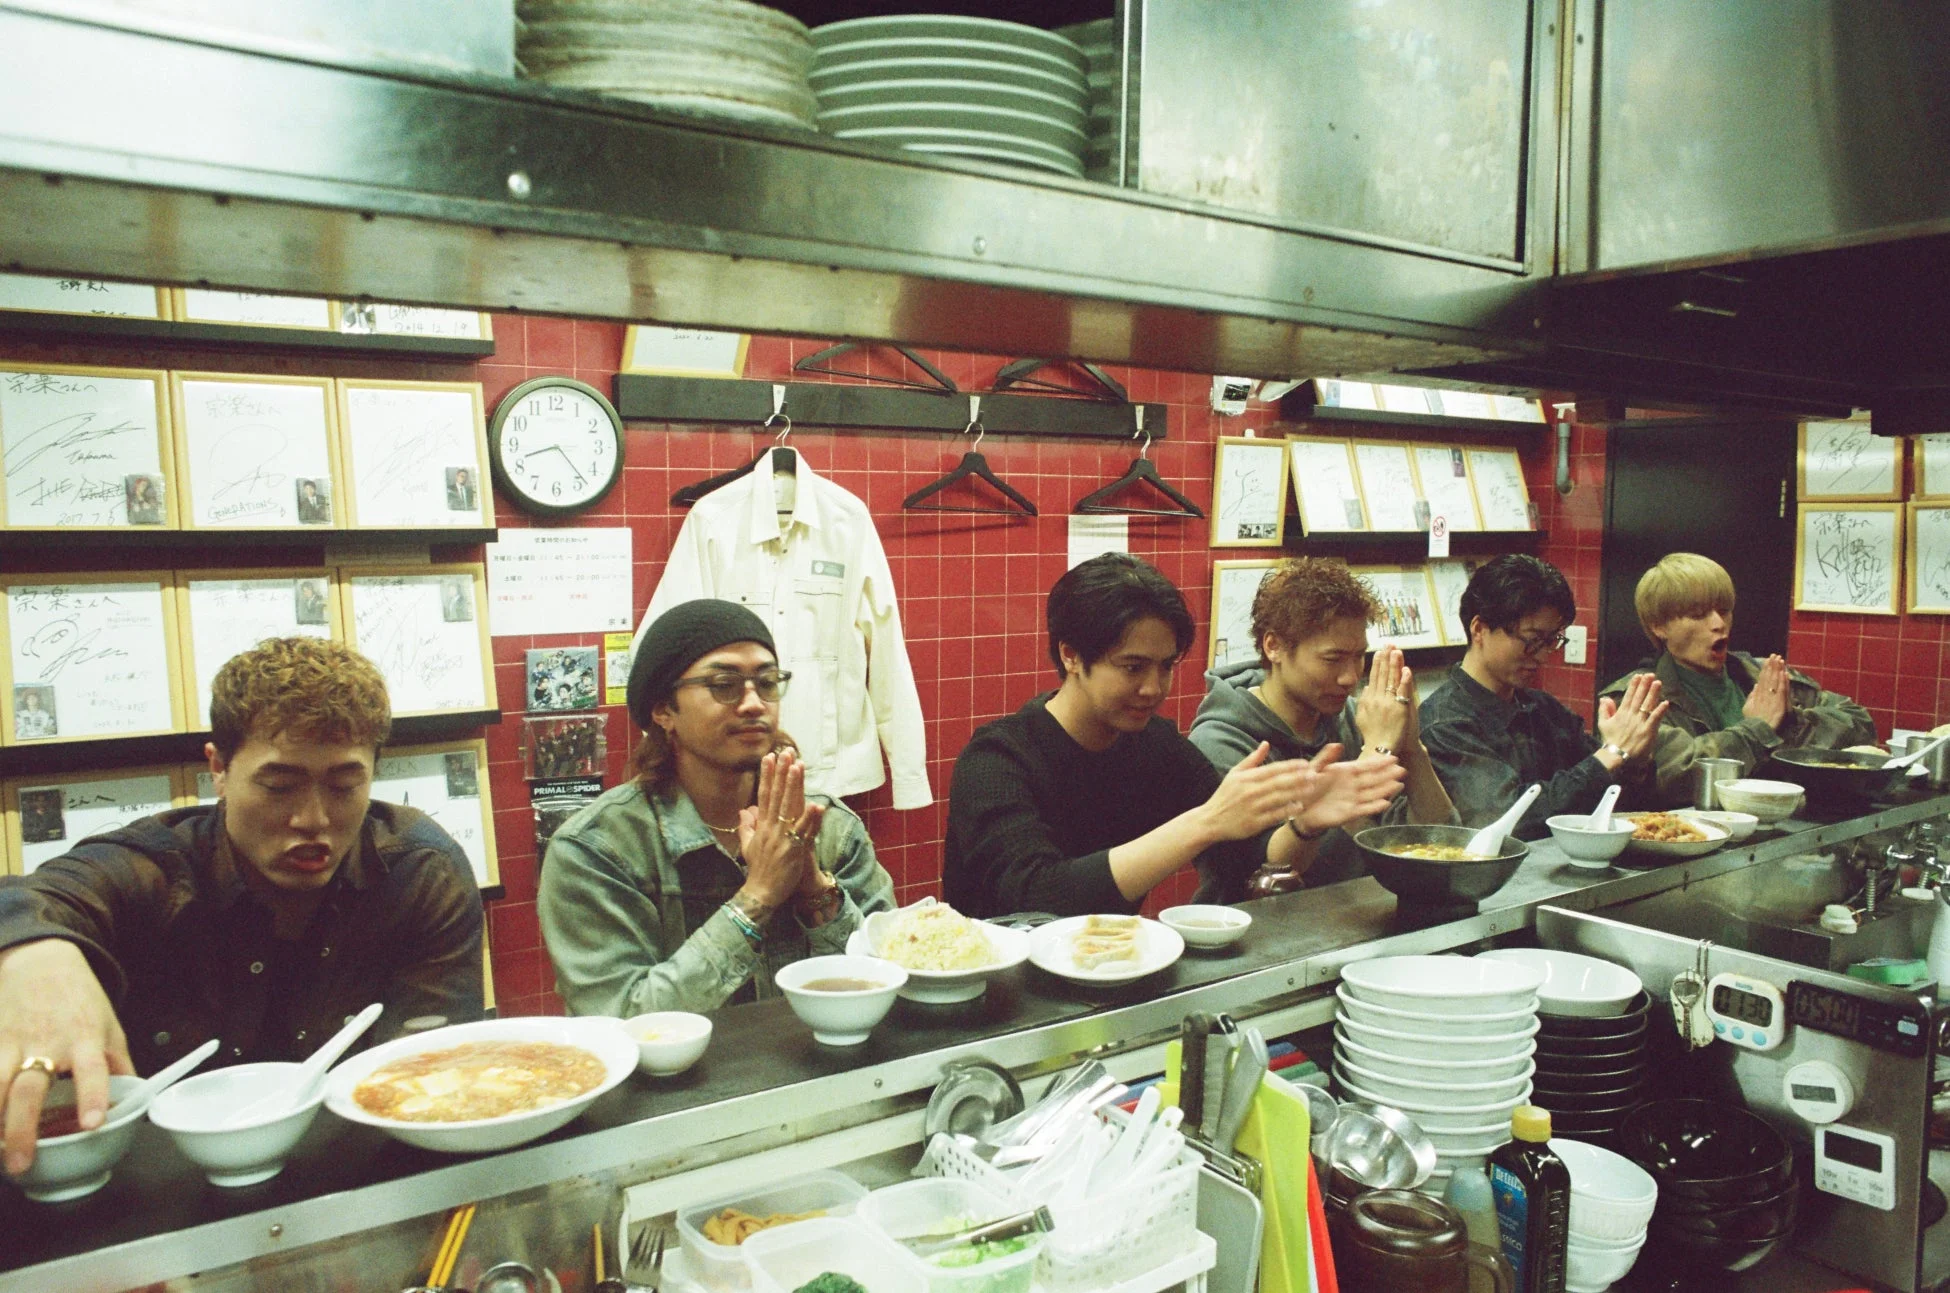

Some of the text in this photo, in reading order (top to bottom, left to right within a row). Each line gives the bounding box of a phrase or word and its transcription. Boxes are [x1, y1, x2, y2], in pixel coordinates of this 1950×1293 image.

[529, 400, 541, 416] 11
[548, 395, 564, 411] 12
[573, 402, 580, 418] 1
[513, 416, 528, 432] 10
[588, 419, 598, 434] 2
[509, 437, 519, 453] 9
[594, 439, 603, 455] 3
[514, 459, 525, 475] 8
[588, 461, 597, 476] 4
[530, 475, 539, 491] 7
[551, 481, 562, 497] 6
[572, 475, 583, 491] 5
[533, 784, 601, 795] PRIMAL SPIDER
